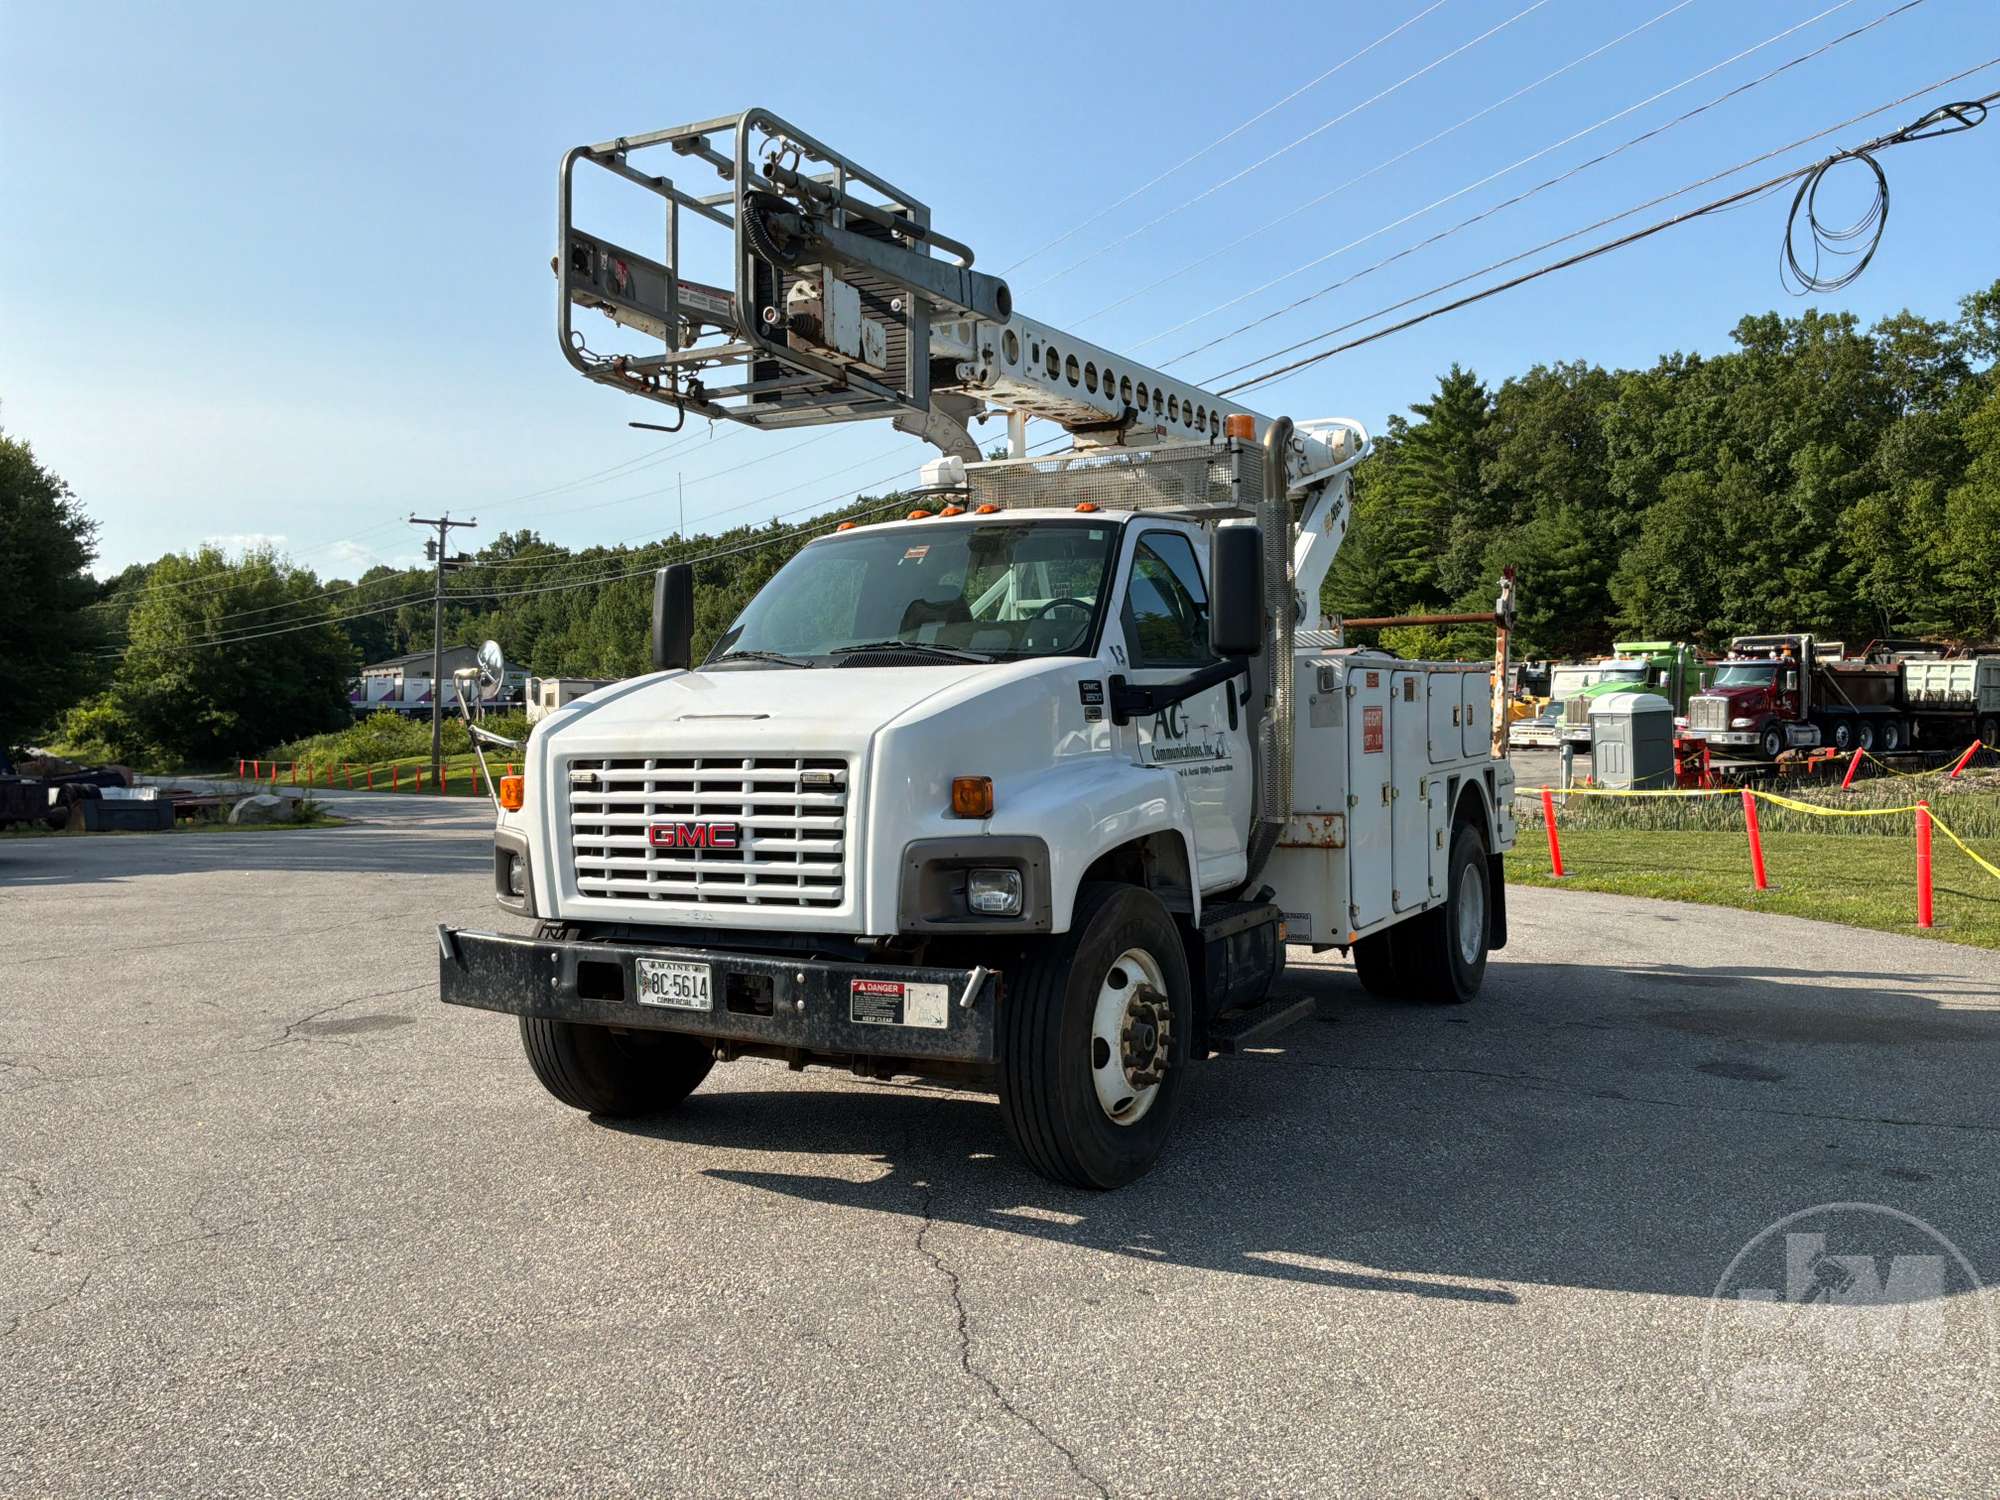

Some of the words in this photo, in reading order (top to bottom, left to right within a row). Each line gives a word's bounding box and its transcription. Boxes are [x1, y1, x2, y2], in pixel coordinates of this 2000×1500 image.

[649, 822, 737, 848] GMC
[658, 963, 690, 972] MAINE
[867, 984, 898, 993] DANGER
